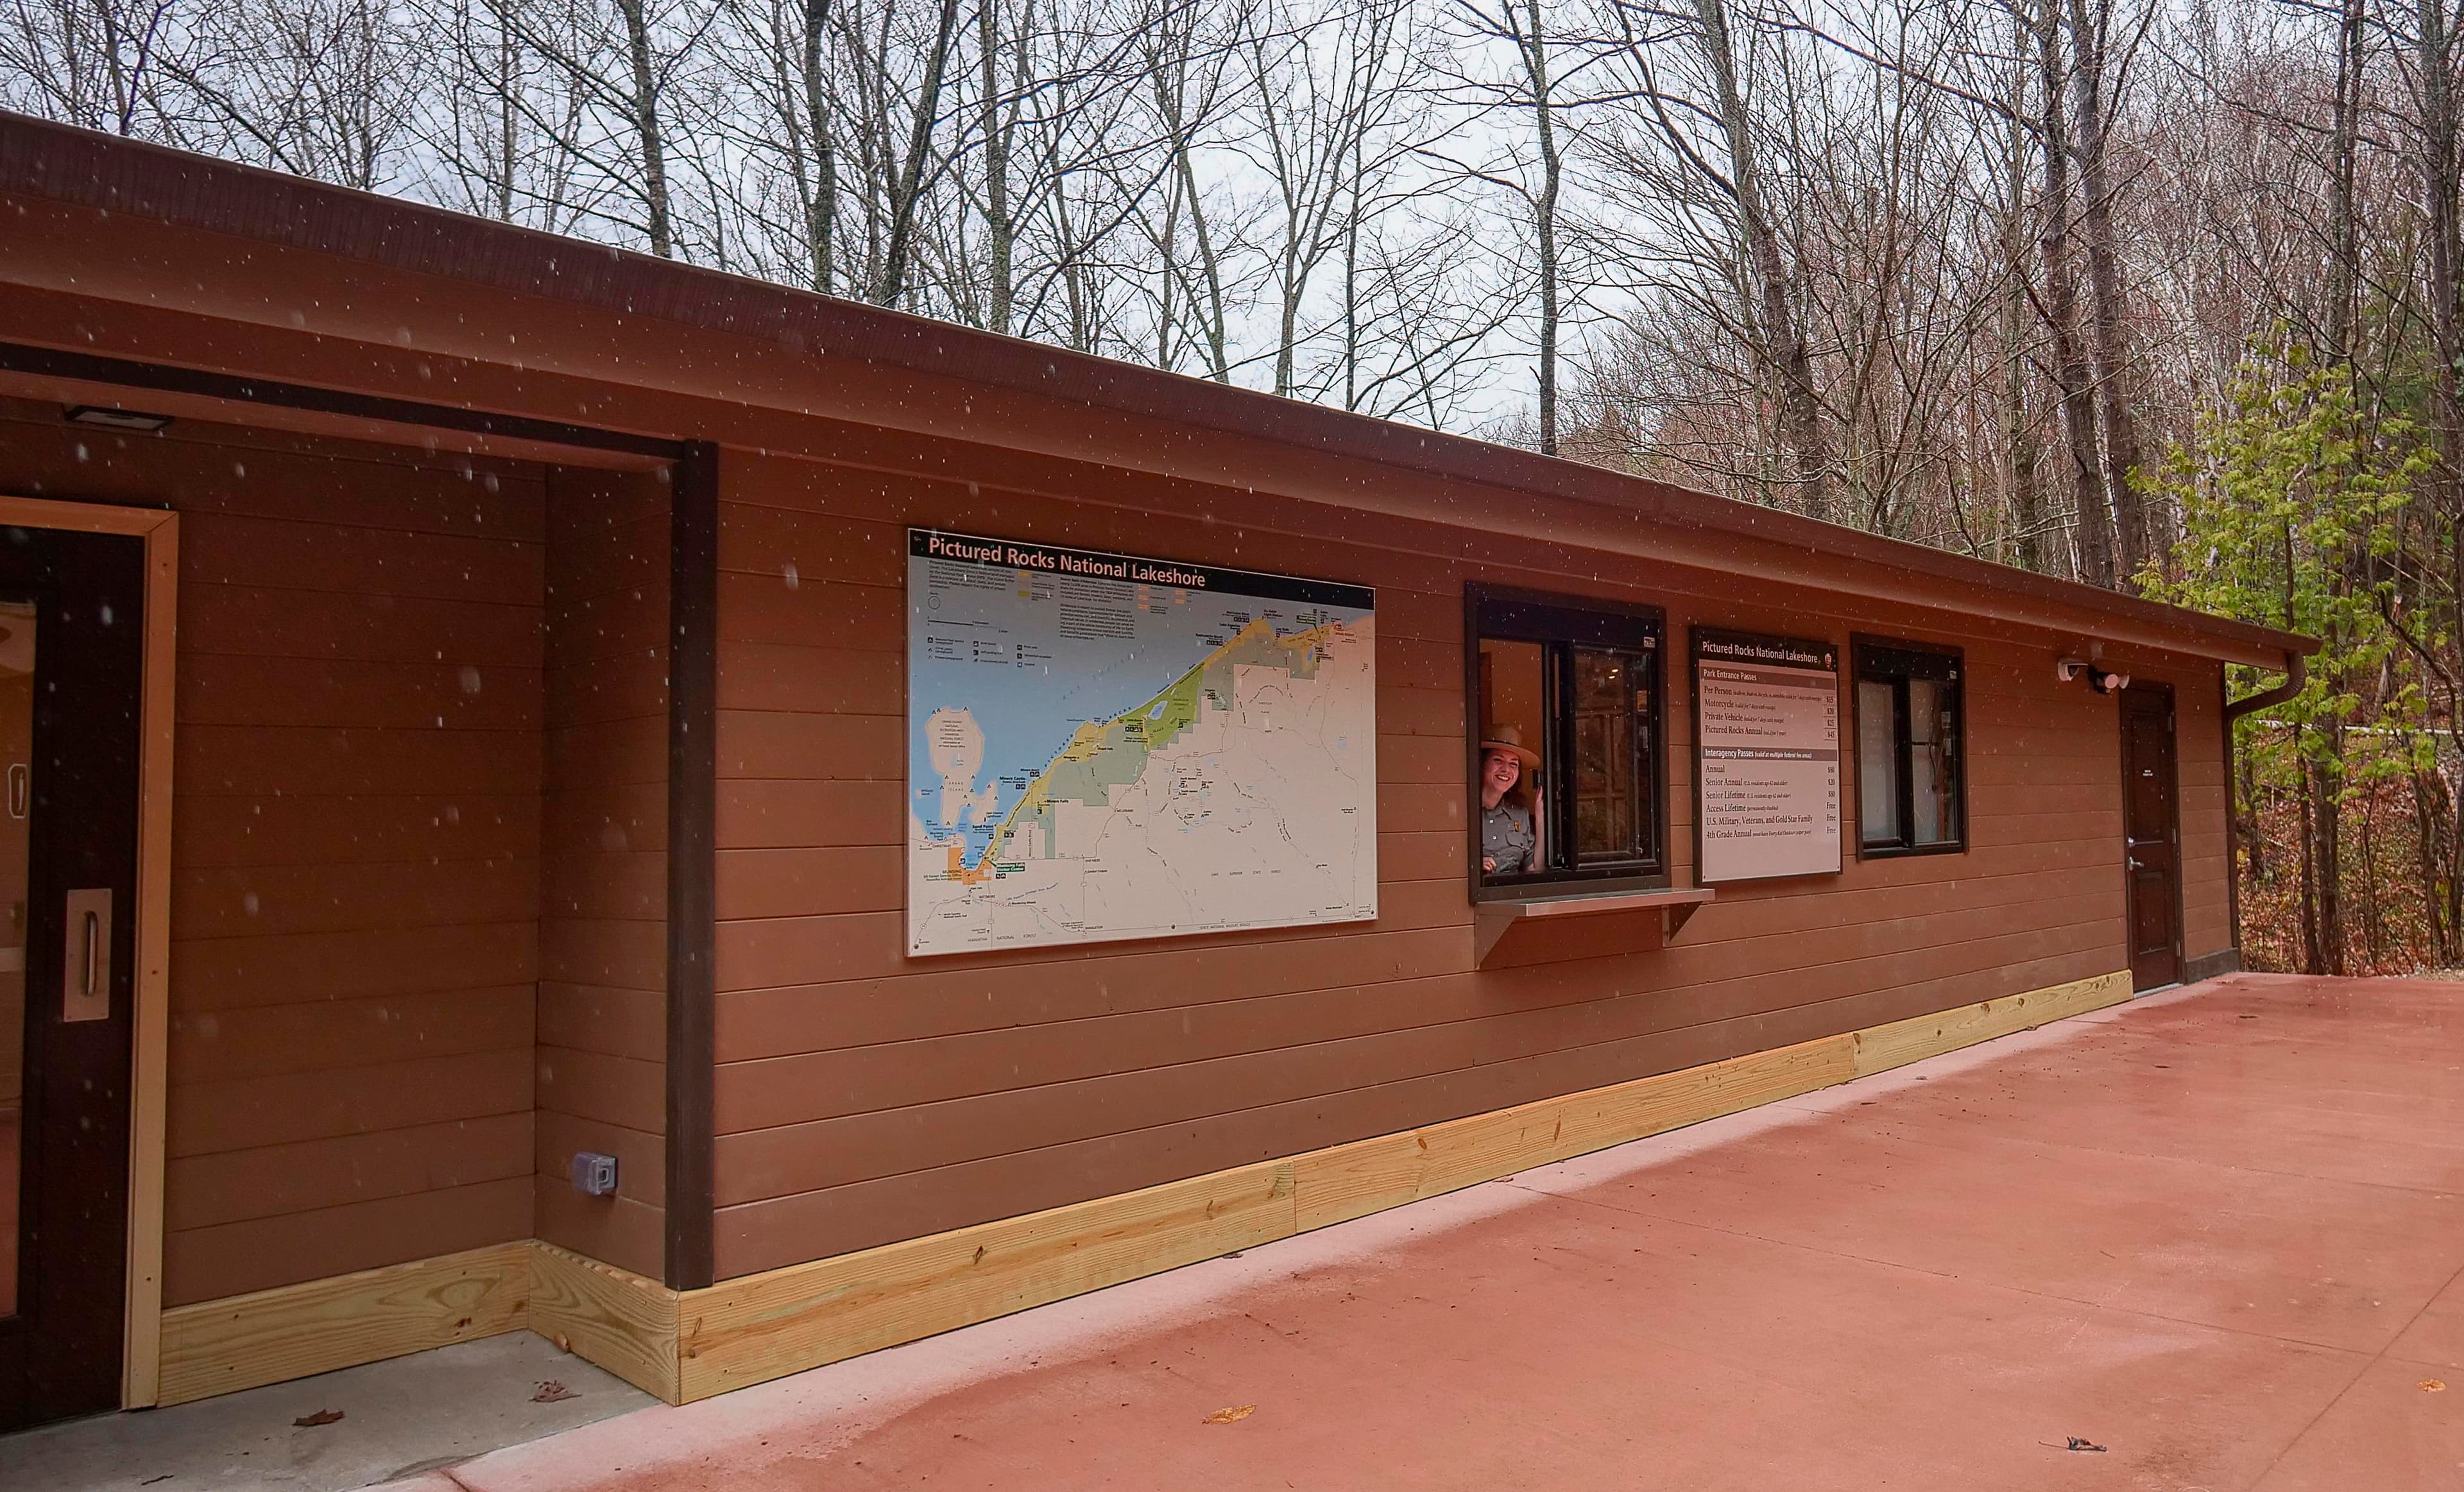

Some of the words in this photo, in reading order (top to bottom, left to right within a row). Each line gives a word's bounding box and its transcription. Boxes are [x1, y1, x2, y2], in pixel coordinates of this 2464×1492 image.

[929, 537, 1002, 562] Pictured
[1008, 548, 1055, 569] Rocks
[1060, 554, 1126, 578] National
[1132, 564, 1206, 587] Lakeshore
[1703, 641, 1733, 654] Pictured
[1735, 644, 1754, 656] Rocks
[1756, 647, 1784, 660] National
[1786, 650, 1818, 663] Lakeshore
[1704, 669, 1716, 678] Park
[1717, 670, 1740, 679] Entrance
[1740, 672, 1757, 680] Passes
[1715, 687, 1733, 695] Person
[1705, 699, 1734, 710] Motorcycle
[1725, 712, 1743, 721] Vehicle
[1706, 725, 1727, 733] Pictured
[1729, 726, 1744, 734] Rocks
[1706, 748, 1736, 759] Interagency
[1738, 749, 1754, 757] Passes
[1706, 791, 1724, 799] Senior
[1725, 791, 1745, 799] Lifetime
[1706, 804, 1724, 812] Access
[1725, 803, 1745, 812] Lifetime
[1707, 817, 1717, 825] U.S.
[1718, 816, 1741, 827] Military,
[1741, 816, 1765, 825] Veterans,
[1775, 815, 1788, 823] Gold
[1798, 814, 1812, 824] Family
[1707, 830, 1716, 839] 4th
